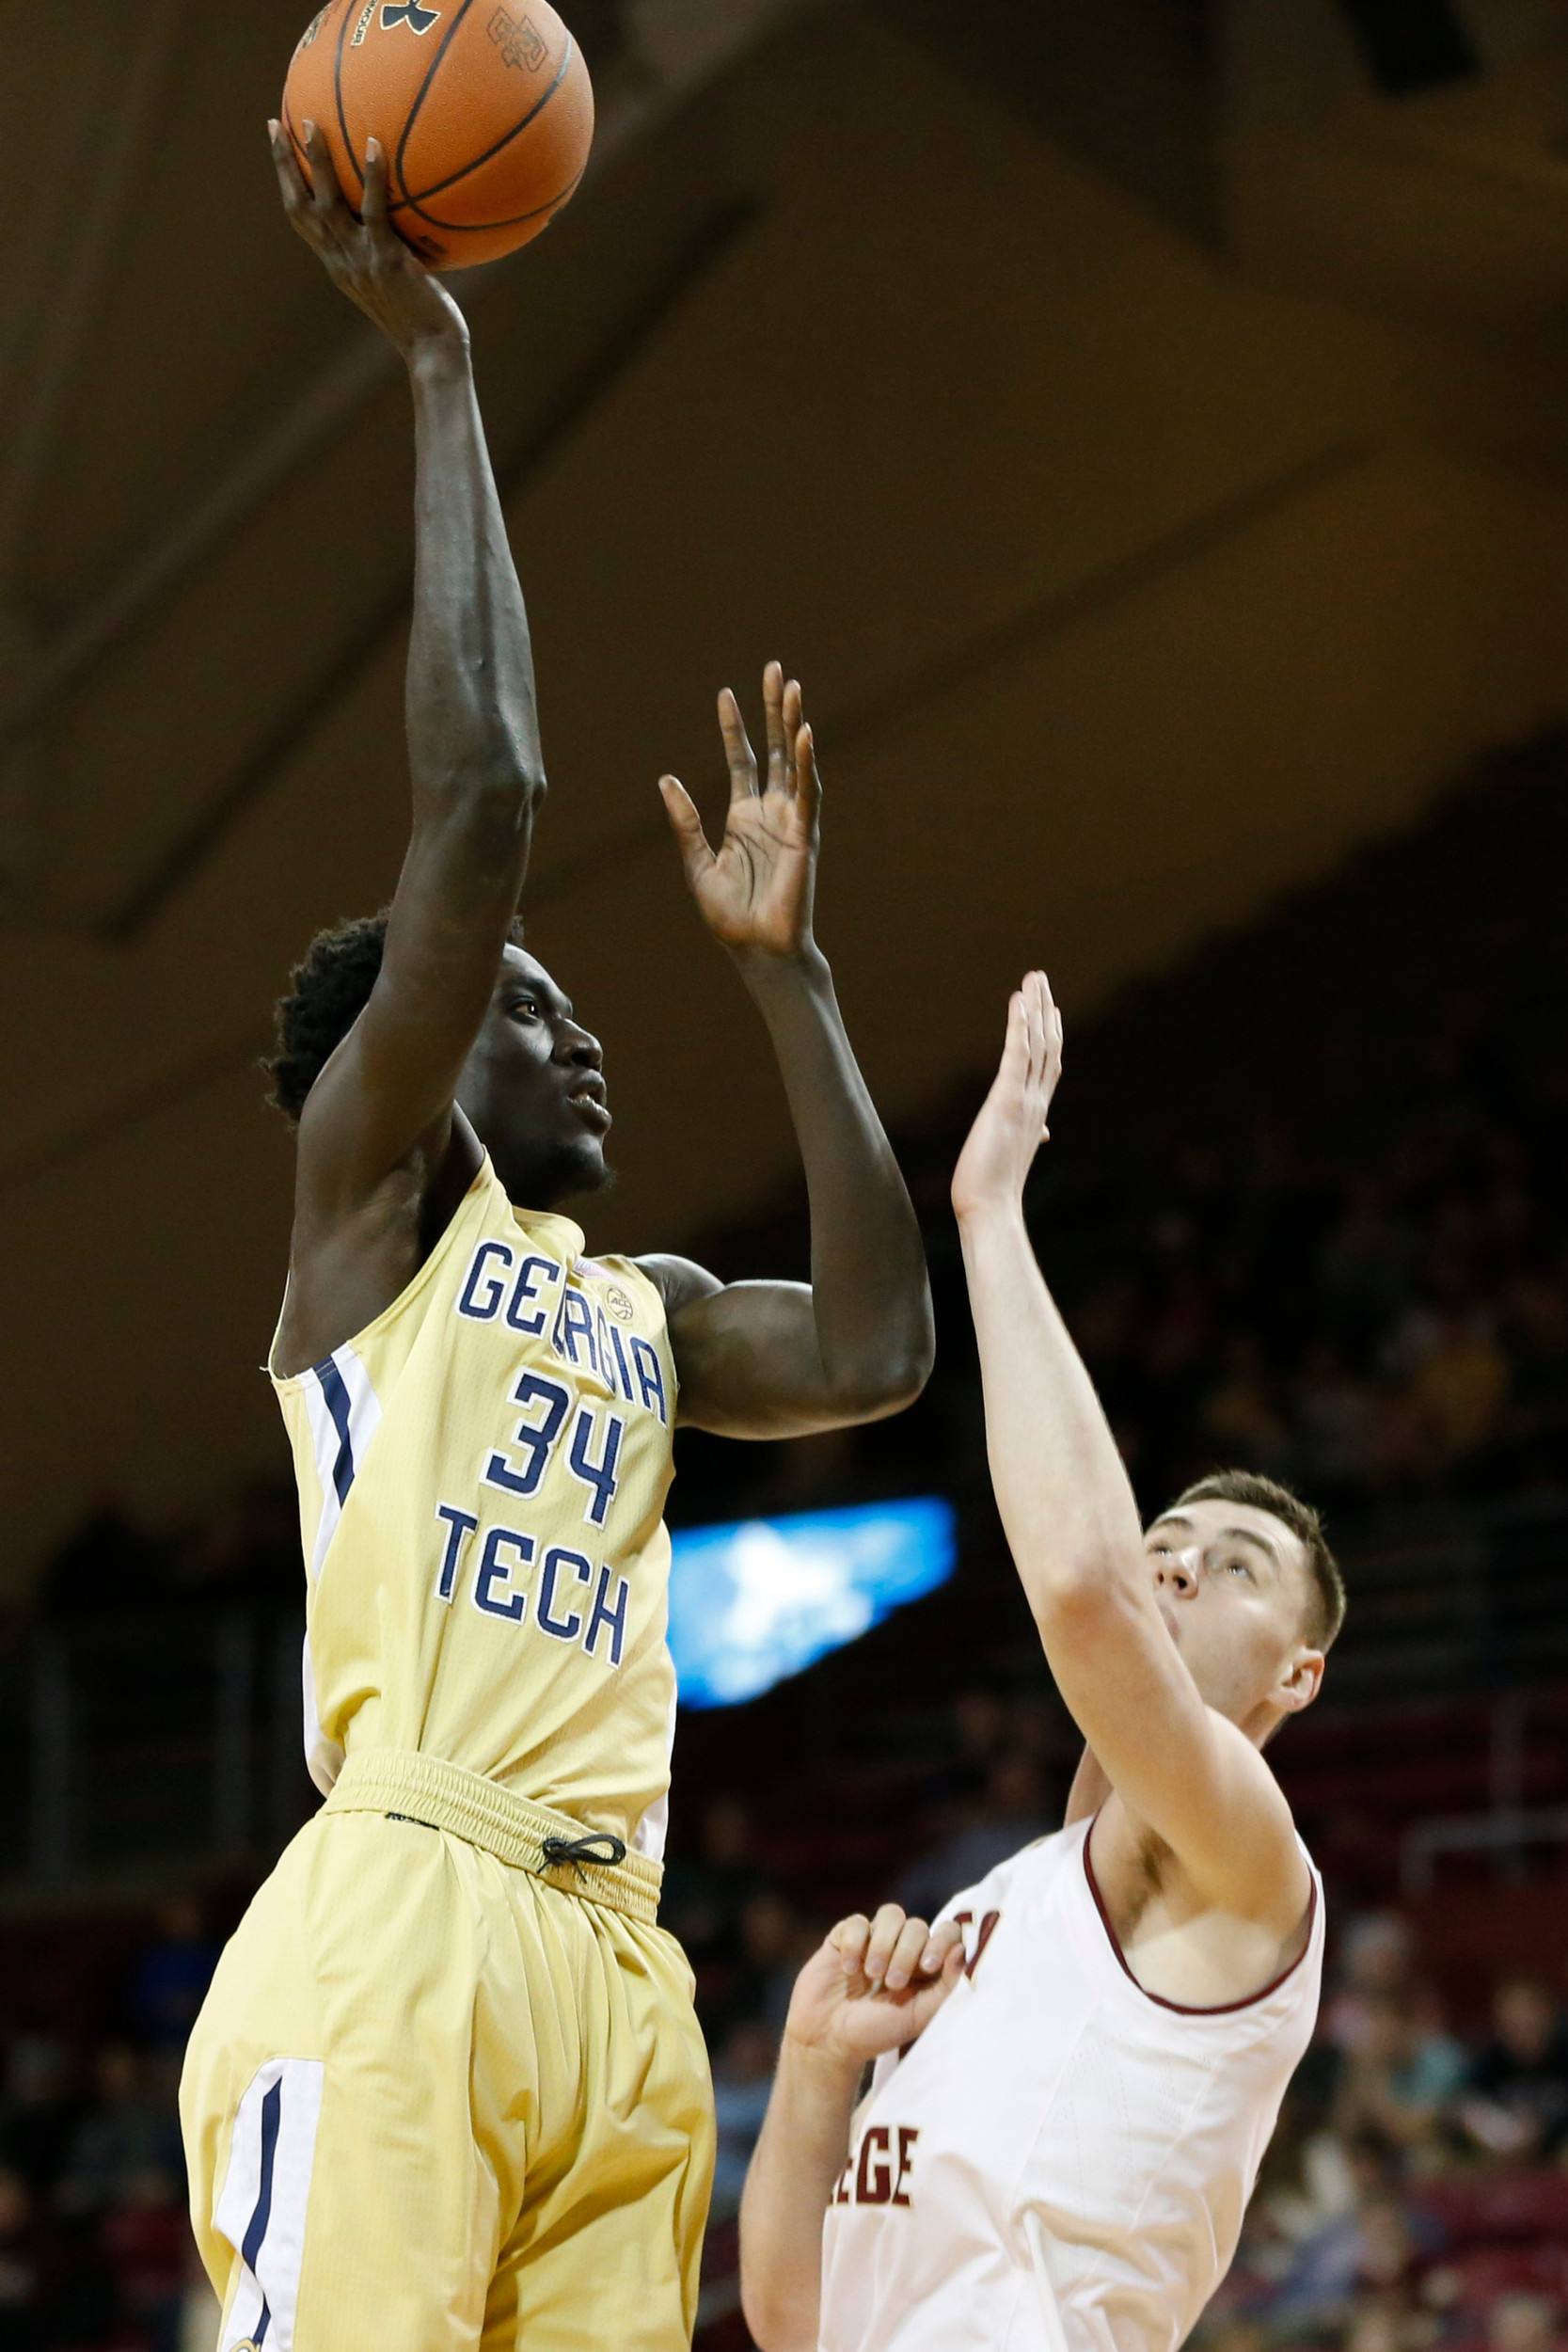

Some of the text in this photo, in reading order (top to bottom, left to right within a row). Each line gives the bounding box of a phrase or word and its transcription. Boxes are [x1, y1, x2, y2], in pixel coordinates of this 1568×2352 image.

[611, 1297, 630, 1309] ACC
[481, 1369, 626, 1530] 34
[435, 1502, 631, 1669] TECH
